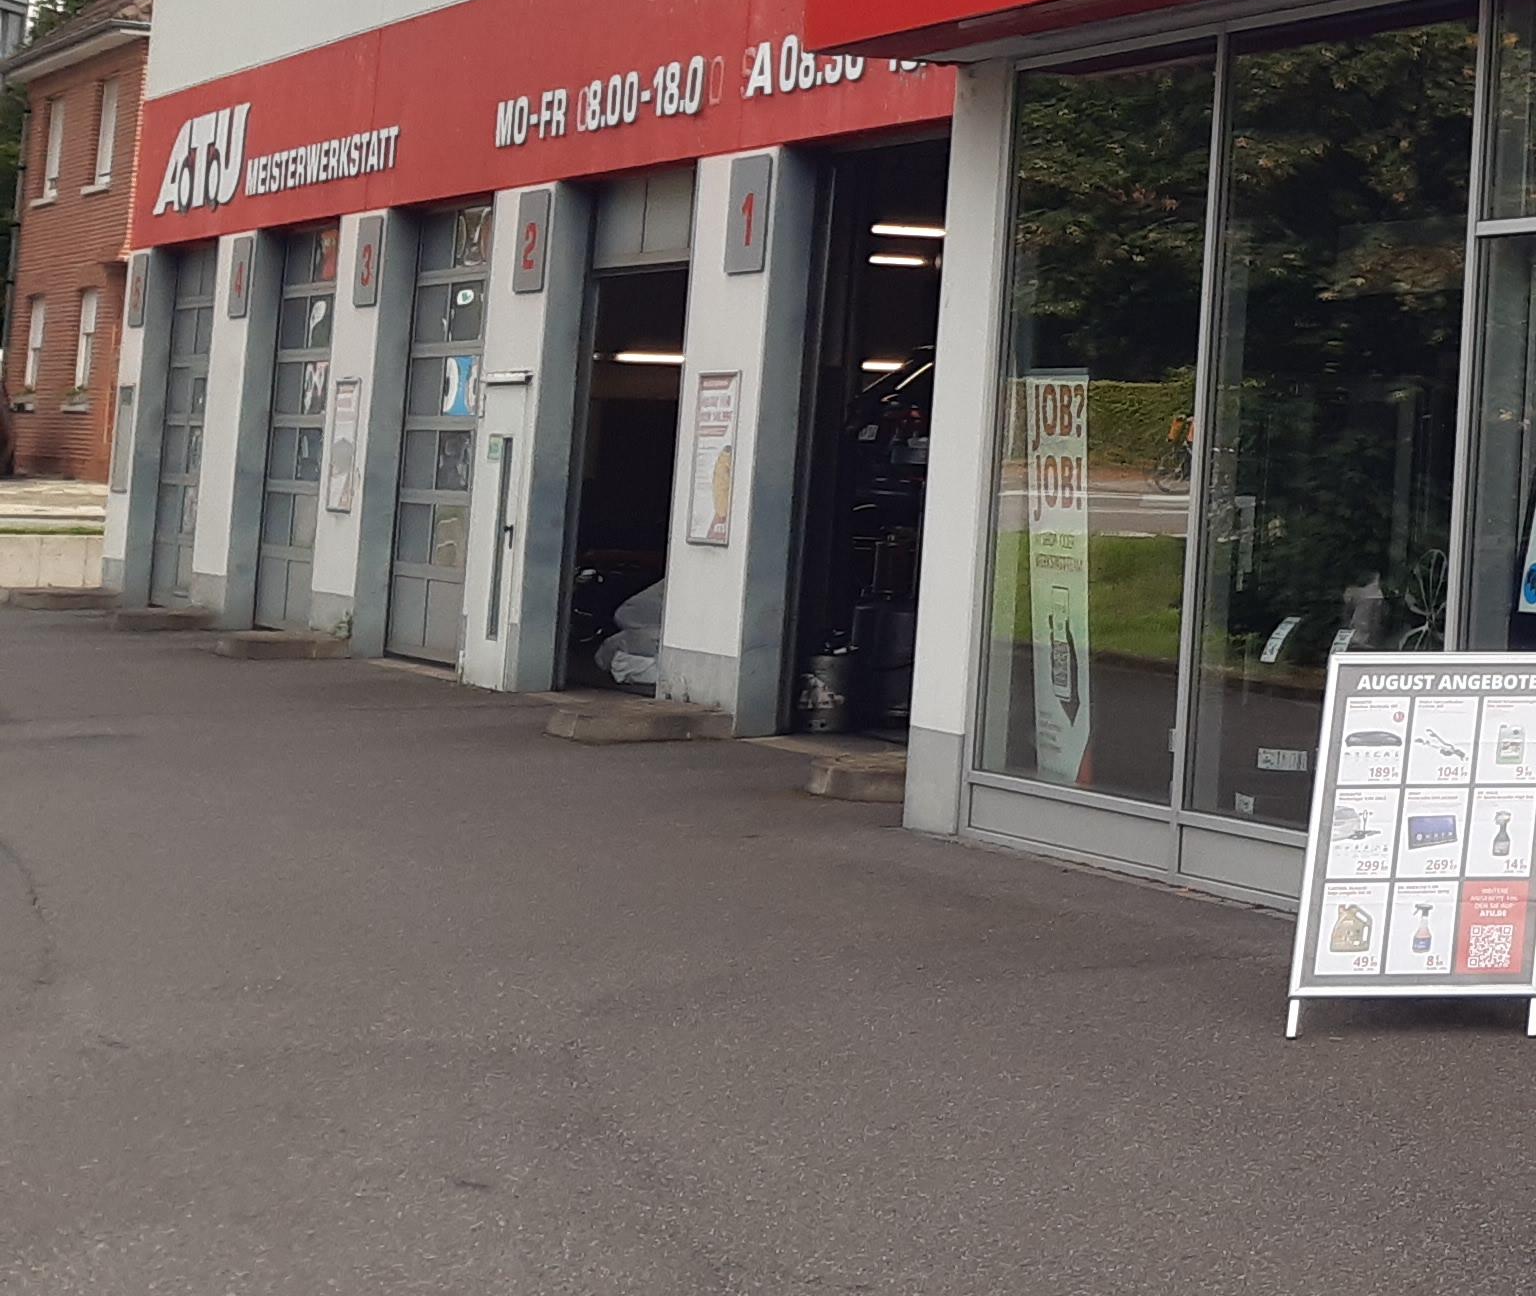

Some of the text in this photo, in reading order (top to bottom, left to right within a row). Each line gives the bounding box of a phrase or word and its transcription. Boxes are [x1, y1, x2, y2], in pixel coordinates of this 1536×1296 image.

[495, 88, 567, 148] MO-FR
[153, 101, 400, 216] ATU MEISTERWERKSTATT
[523, 222, 537, 270] 2
[741, 192, 755, 247] 1
[360, 242, 374, 288] 3
[1031, 383, 1085, 452] JOB?
[1033, 454, 1083, 522] JOB!
[1356, 674, 1436, 691] AUGUST
